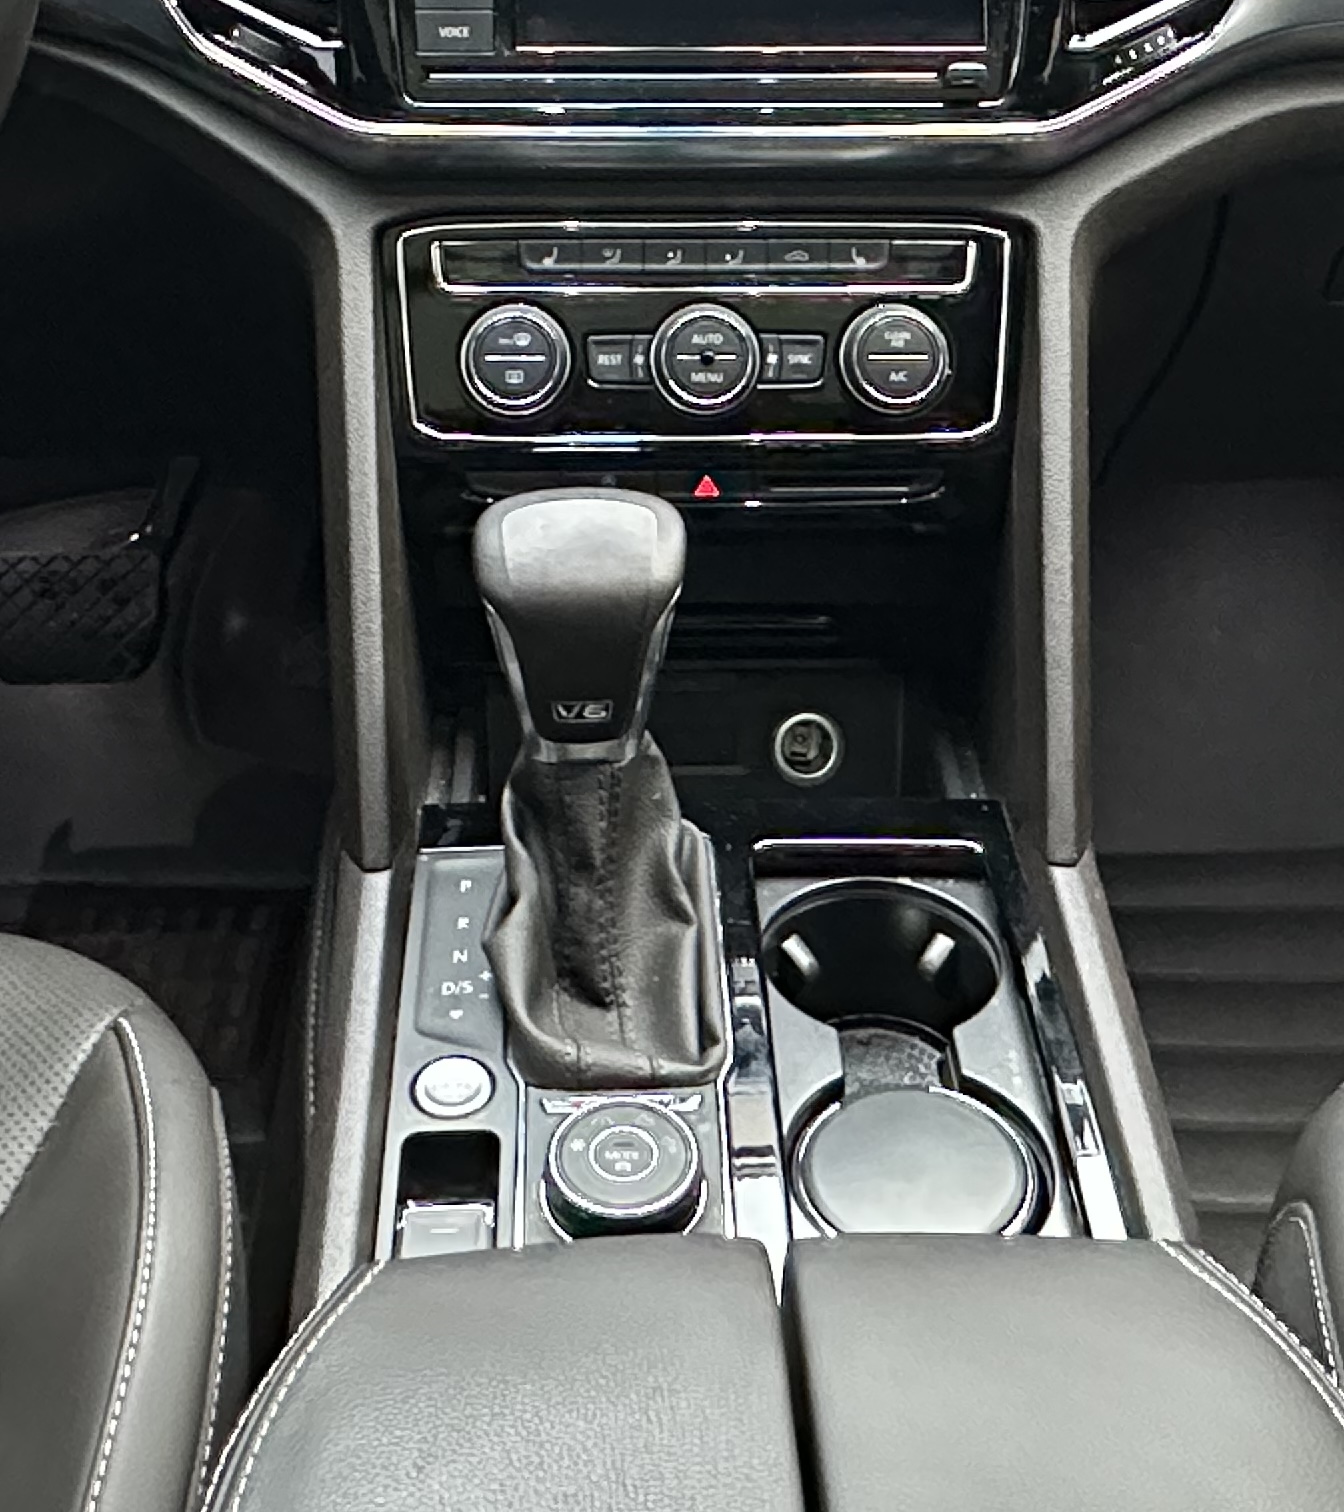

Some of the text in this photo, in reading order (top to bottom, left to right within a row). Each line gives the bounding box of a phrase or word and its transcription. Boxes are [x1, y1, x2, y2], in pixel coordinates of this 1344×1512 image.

[438, 26, 470, 38] VOICE
[691, 332, 724, 346] AUTO
[597, 354, 622, 366] REST
[787, 353, 812, 364] SYNC
[690, 372, 724, 384] MENU
[556, 702, 607, 718] V6
[460, 879, 472, 893] P
[456, 917, 470, 930] R
[452, 949, 468, 964] N
[441, 980, 474, 996] D/S
